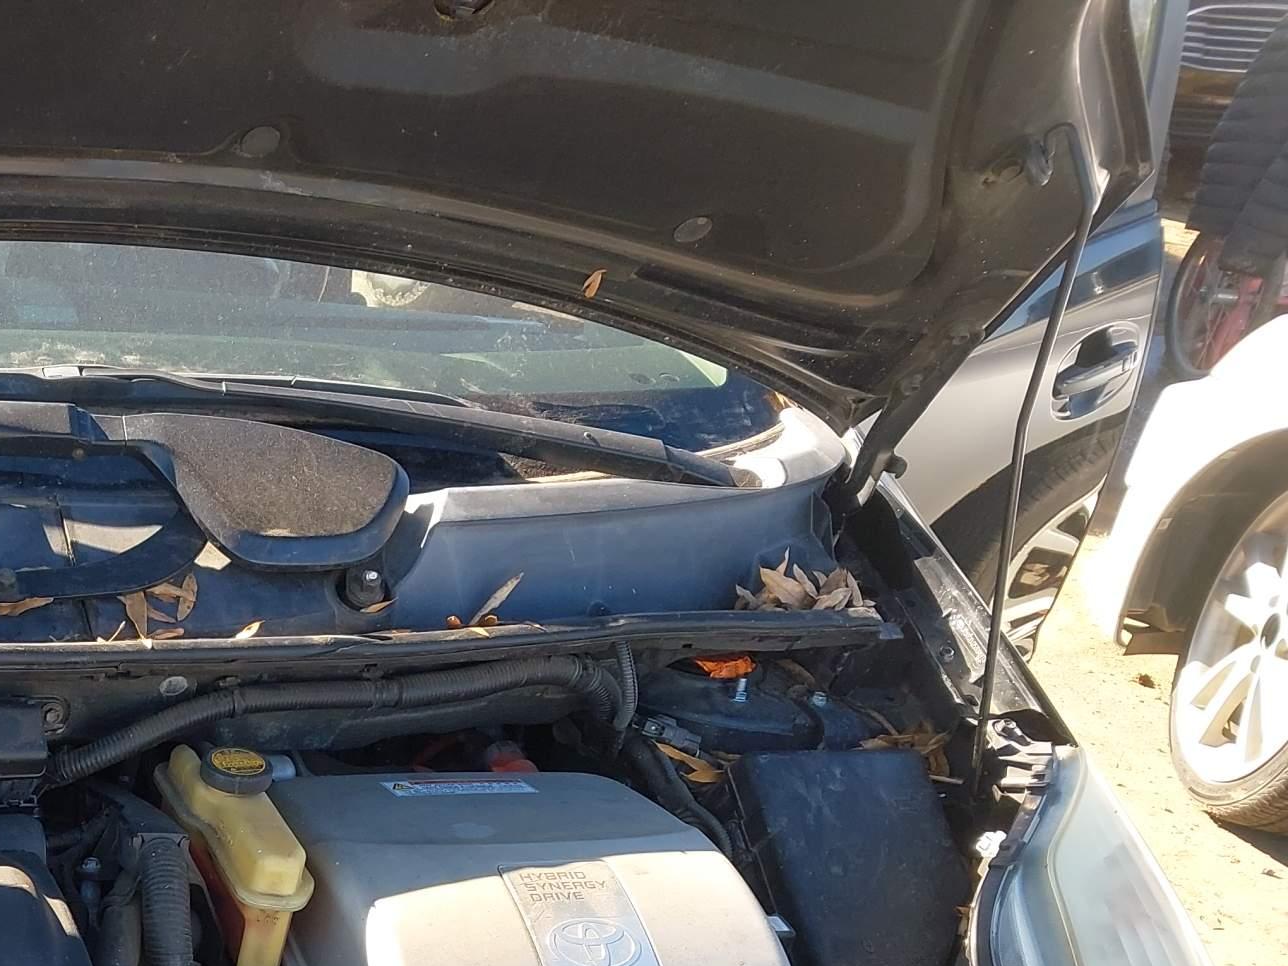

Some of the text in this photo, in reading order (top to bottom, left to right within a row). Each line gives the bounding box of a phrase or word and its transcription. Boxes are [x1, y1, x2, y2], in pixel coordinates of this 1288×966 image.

[520, 872, 586, 881] HYBRID
[524, 881, 606, 892] SYNERGY
[531, 892, 585, 902] DRIVE
